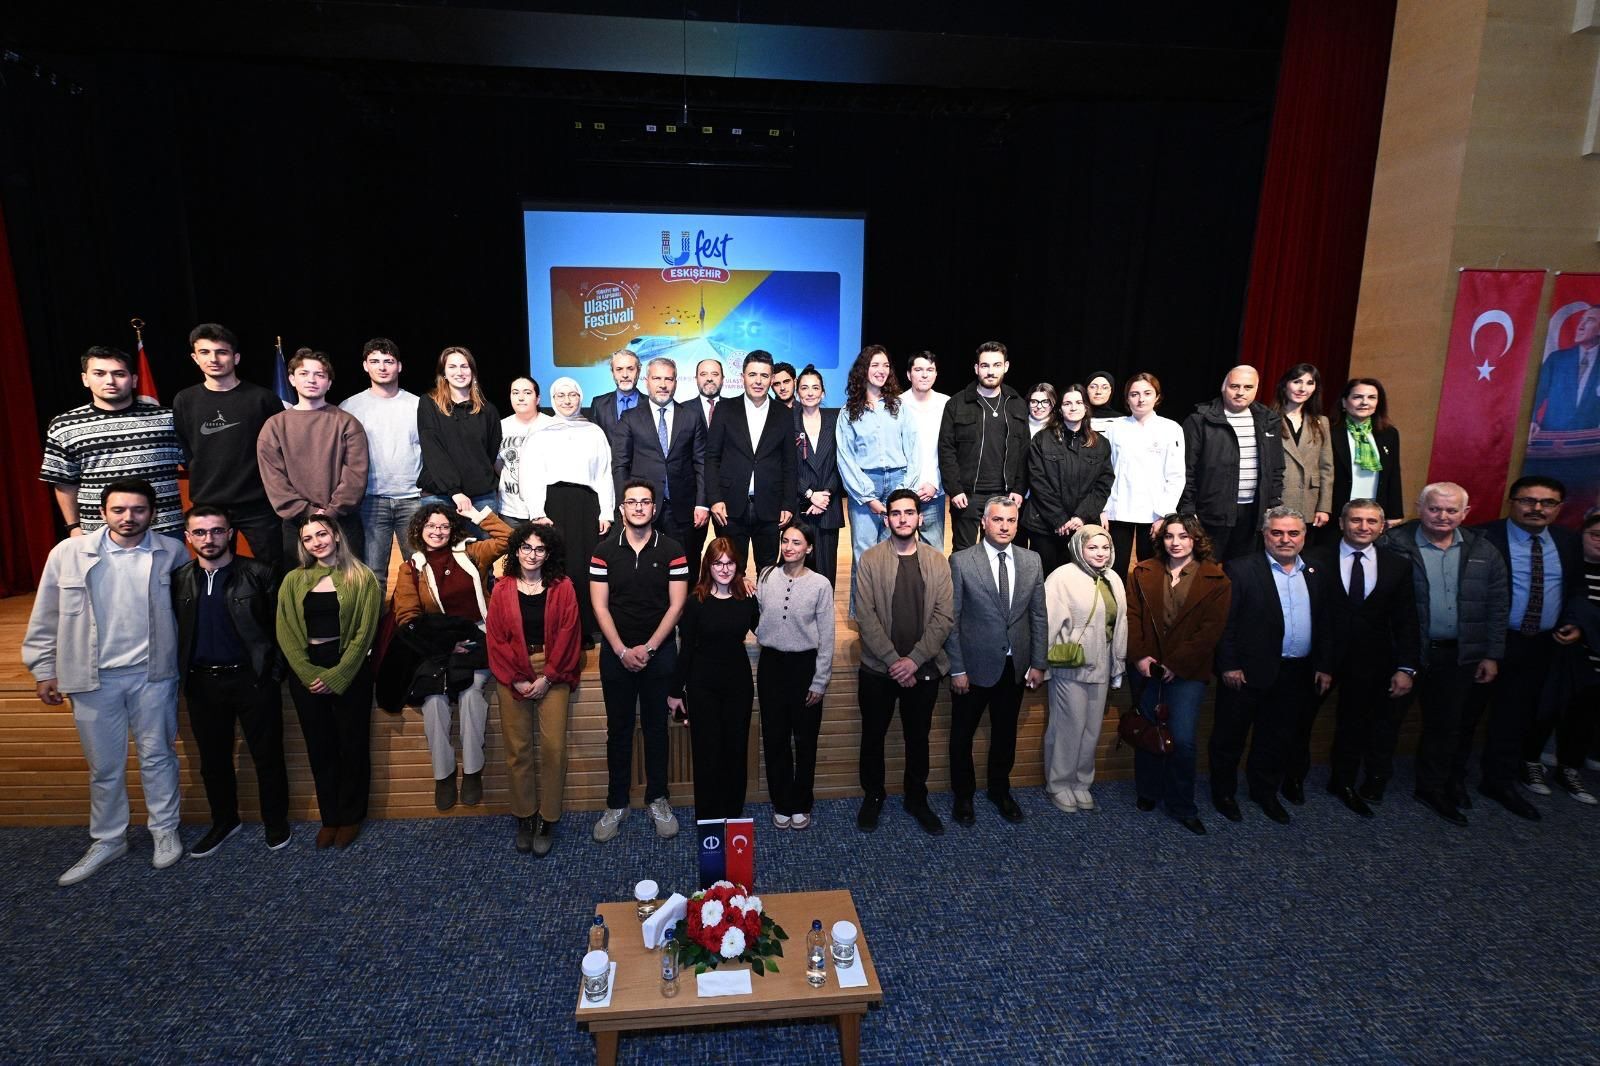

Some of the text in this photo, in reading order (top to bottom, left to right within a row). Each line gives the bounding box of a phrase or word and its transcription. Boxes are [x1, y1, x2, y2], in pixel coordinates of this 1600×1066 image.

[670, 268, 722, 279] ESKİŞEHİR
[584, 297, 624, 314] Ulaşım
[584, 306, 634, 329] Festivali
